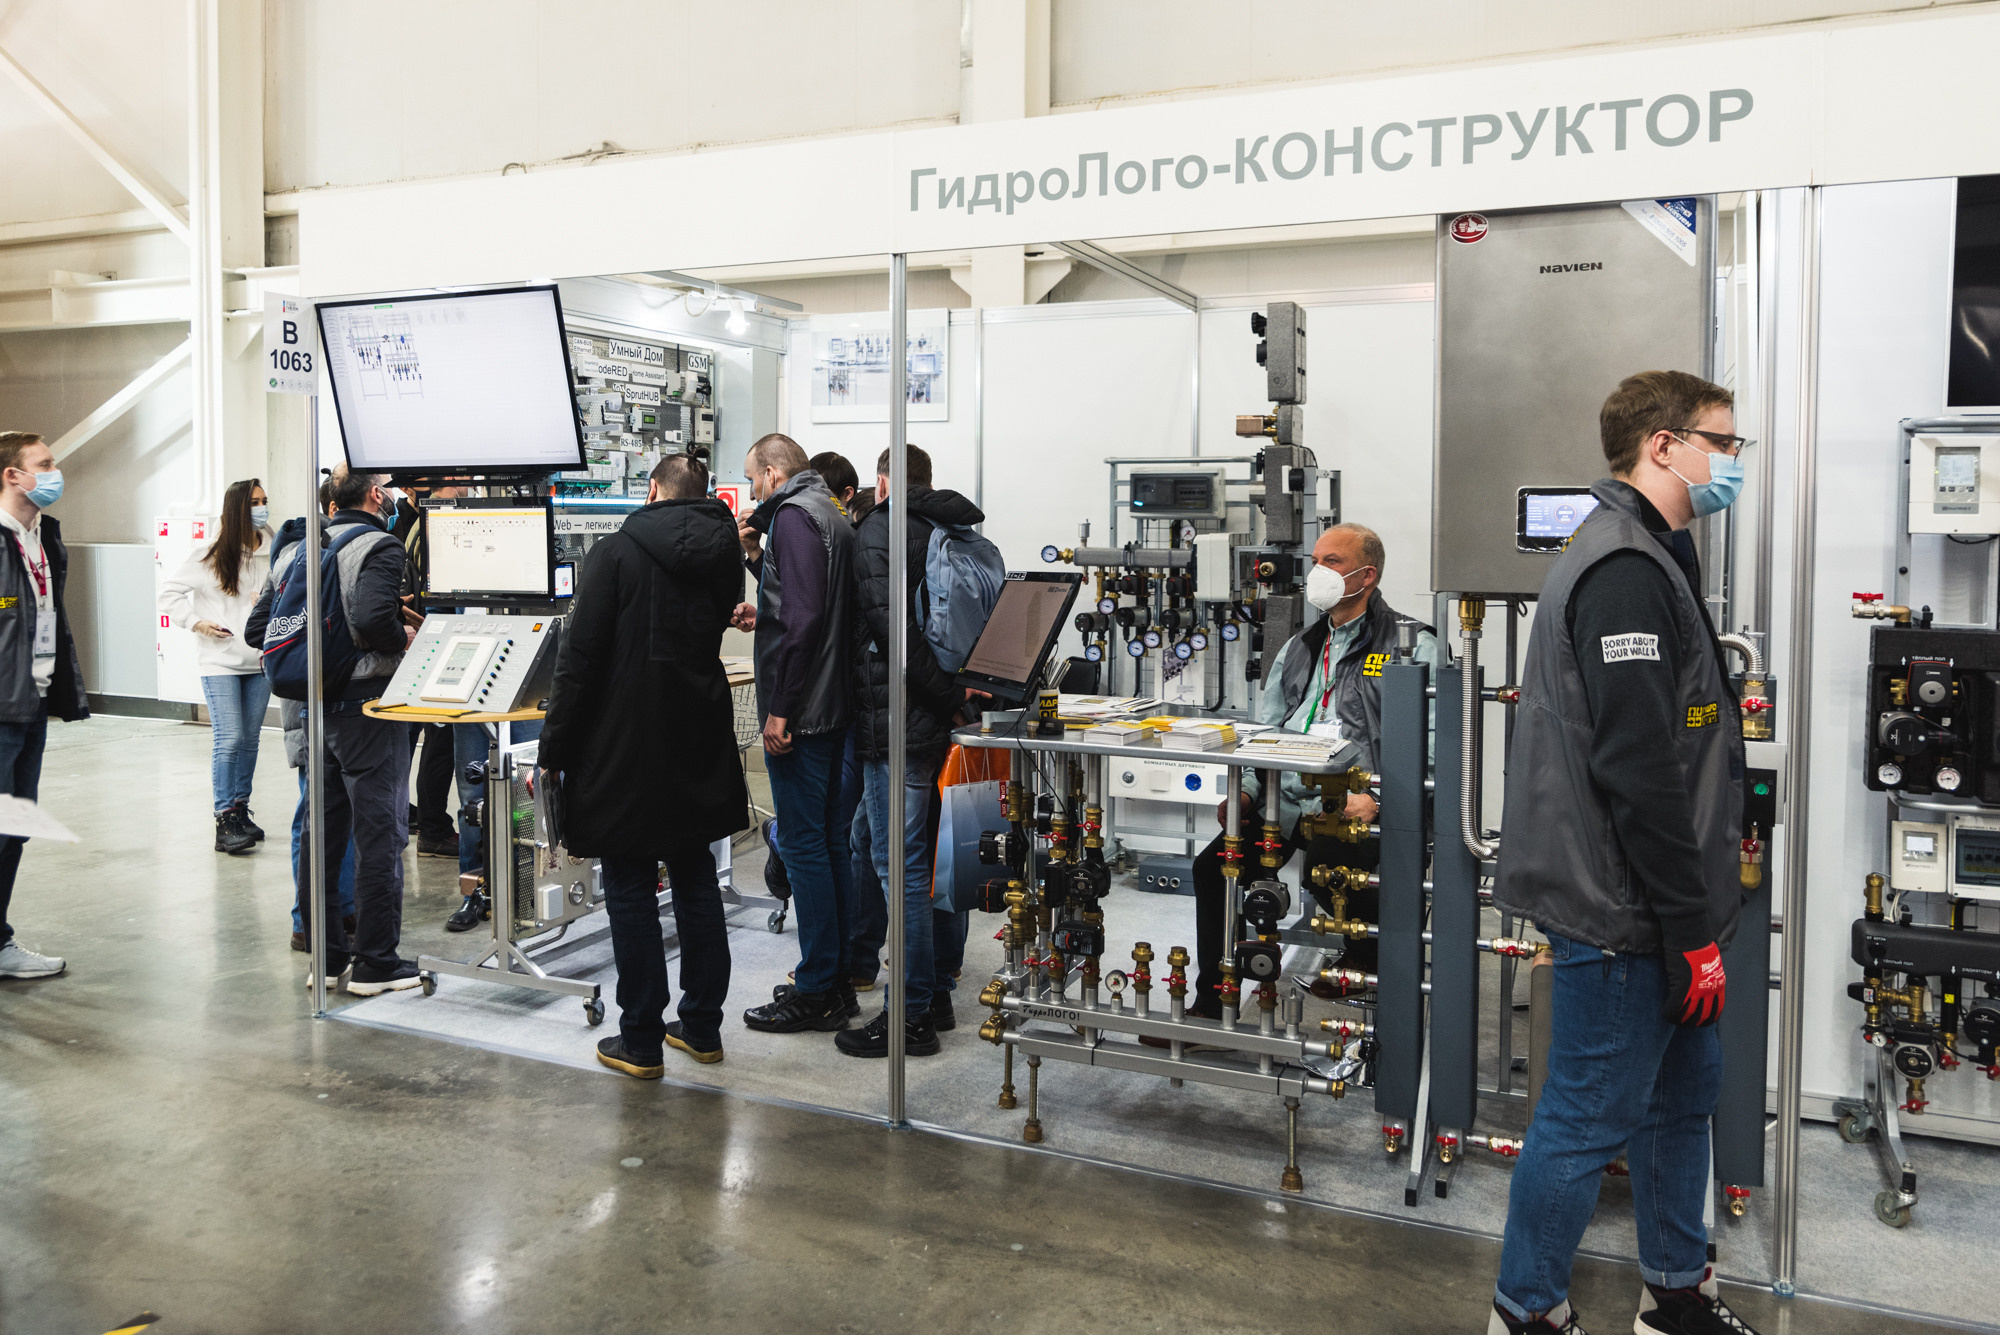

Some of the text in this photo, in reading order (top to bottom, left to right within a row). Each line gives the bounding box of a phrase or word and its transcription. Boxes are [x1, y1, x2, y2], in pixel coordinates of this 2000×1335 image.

[910, 88, 1754, 215] ГидроЛого-КОНСТРУКТОР
[283, 320, 298, 345] B
[610, 341, 663, 362] Умный Дом
[270, 348, 313, 373] 1063
[688, 354, 707, 370] GSM
[598, 364, 628, 377] odeRED
[625, 388, 659, 402] SprutHUB
[620, 437, 642, 448] RS-485
[584, 521, 613, 531] легкие
[613, 522, 623, 530] ко
[1603, 636, 1656, 649] SORRY ABOUT
[1604, 647, 1650, 659] YOUR WALL
